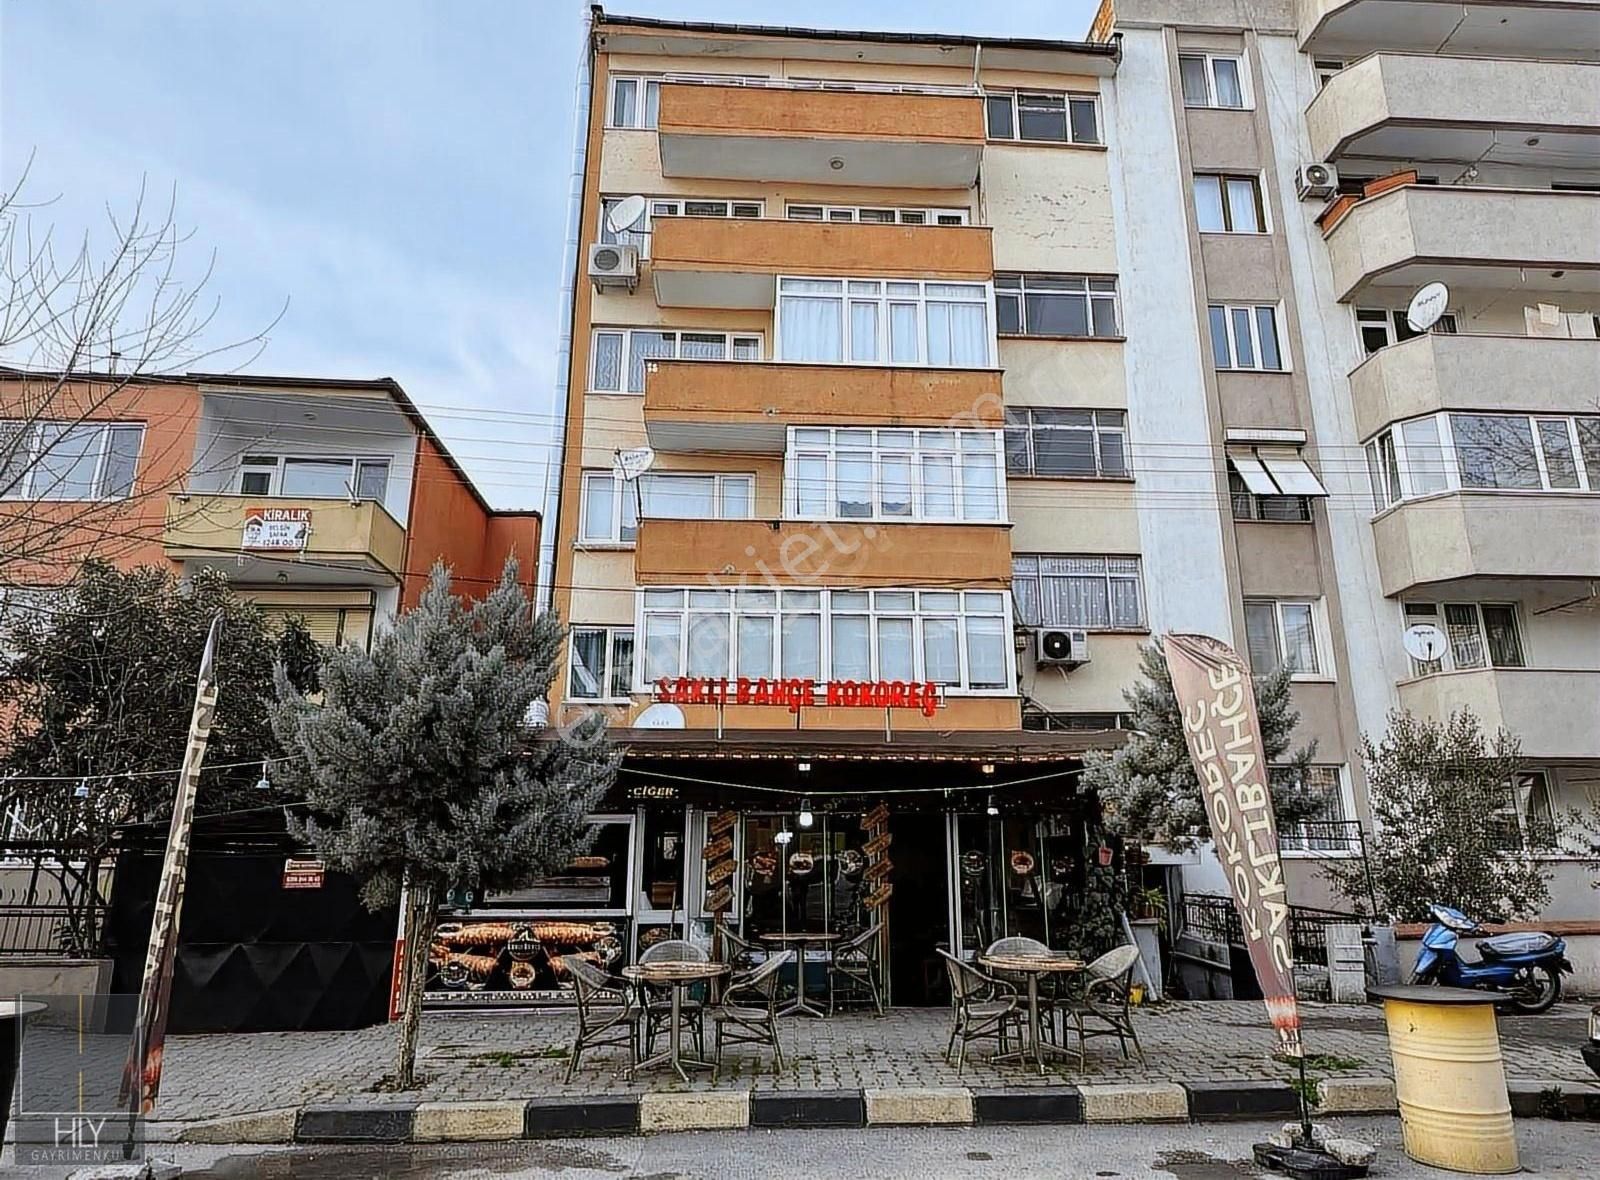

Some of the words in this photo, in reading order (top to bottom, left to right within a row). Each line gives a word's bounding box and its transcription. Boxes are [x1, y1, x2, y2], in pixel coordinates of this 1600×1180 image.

[263, 508, 309, 520] KİRALIK
[657, 677, 728, 703] SAKLI
[736, 677, 814, 713] BAHÇE
[827, 680, 937, 717] KOKOREÇ
